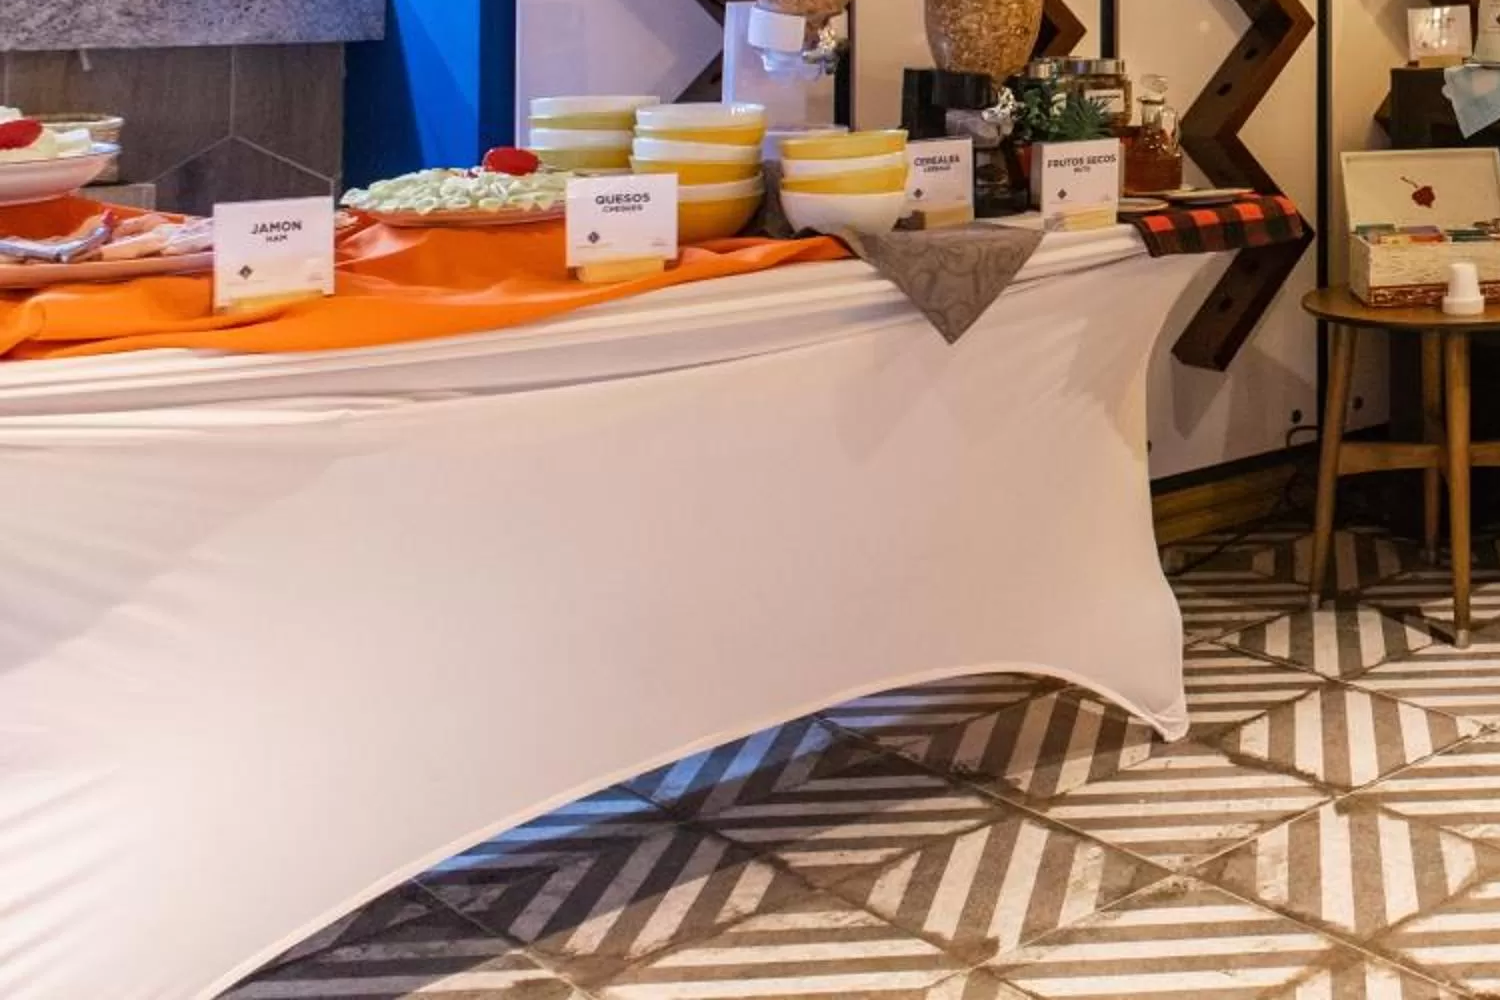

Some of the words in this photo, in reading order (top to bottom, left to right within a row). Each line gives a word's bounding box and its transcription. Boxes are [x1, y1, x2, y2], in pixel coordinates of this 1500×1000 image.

[1047, 157, 1084, 168] FRUTOS
[1087, 154, 1116, 164] SECOS
[595, 192, 651, 205] QUESOS
[250, 220, 302, 234] JAMON
